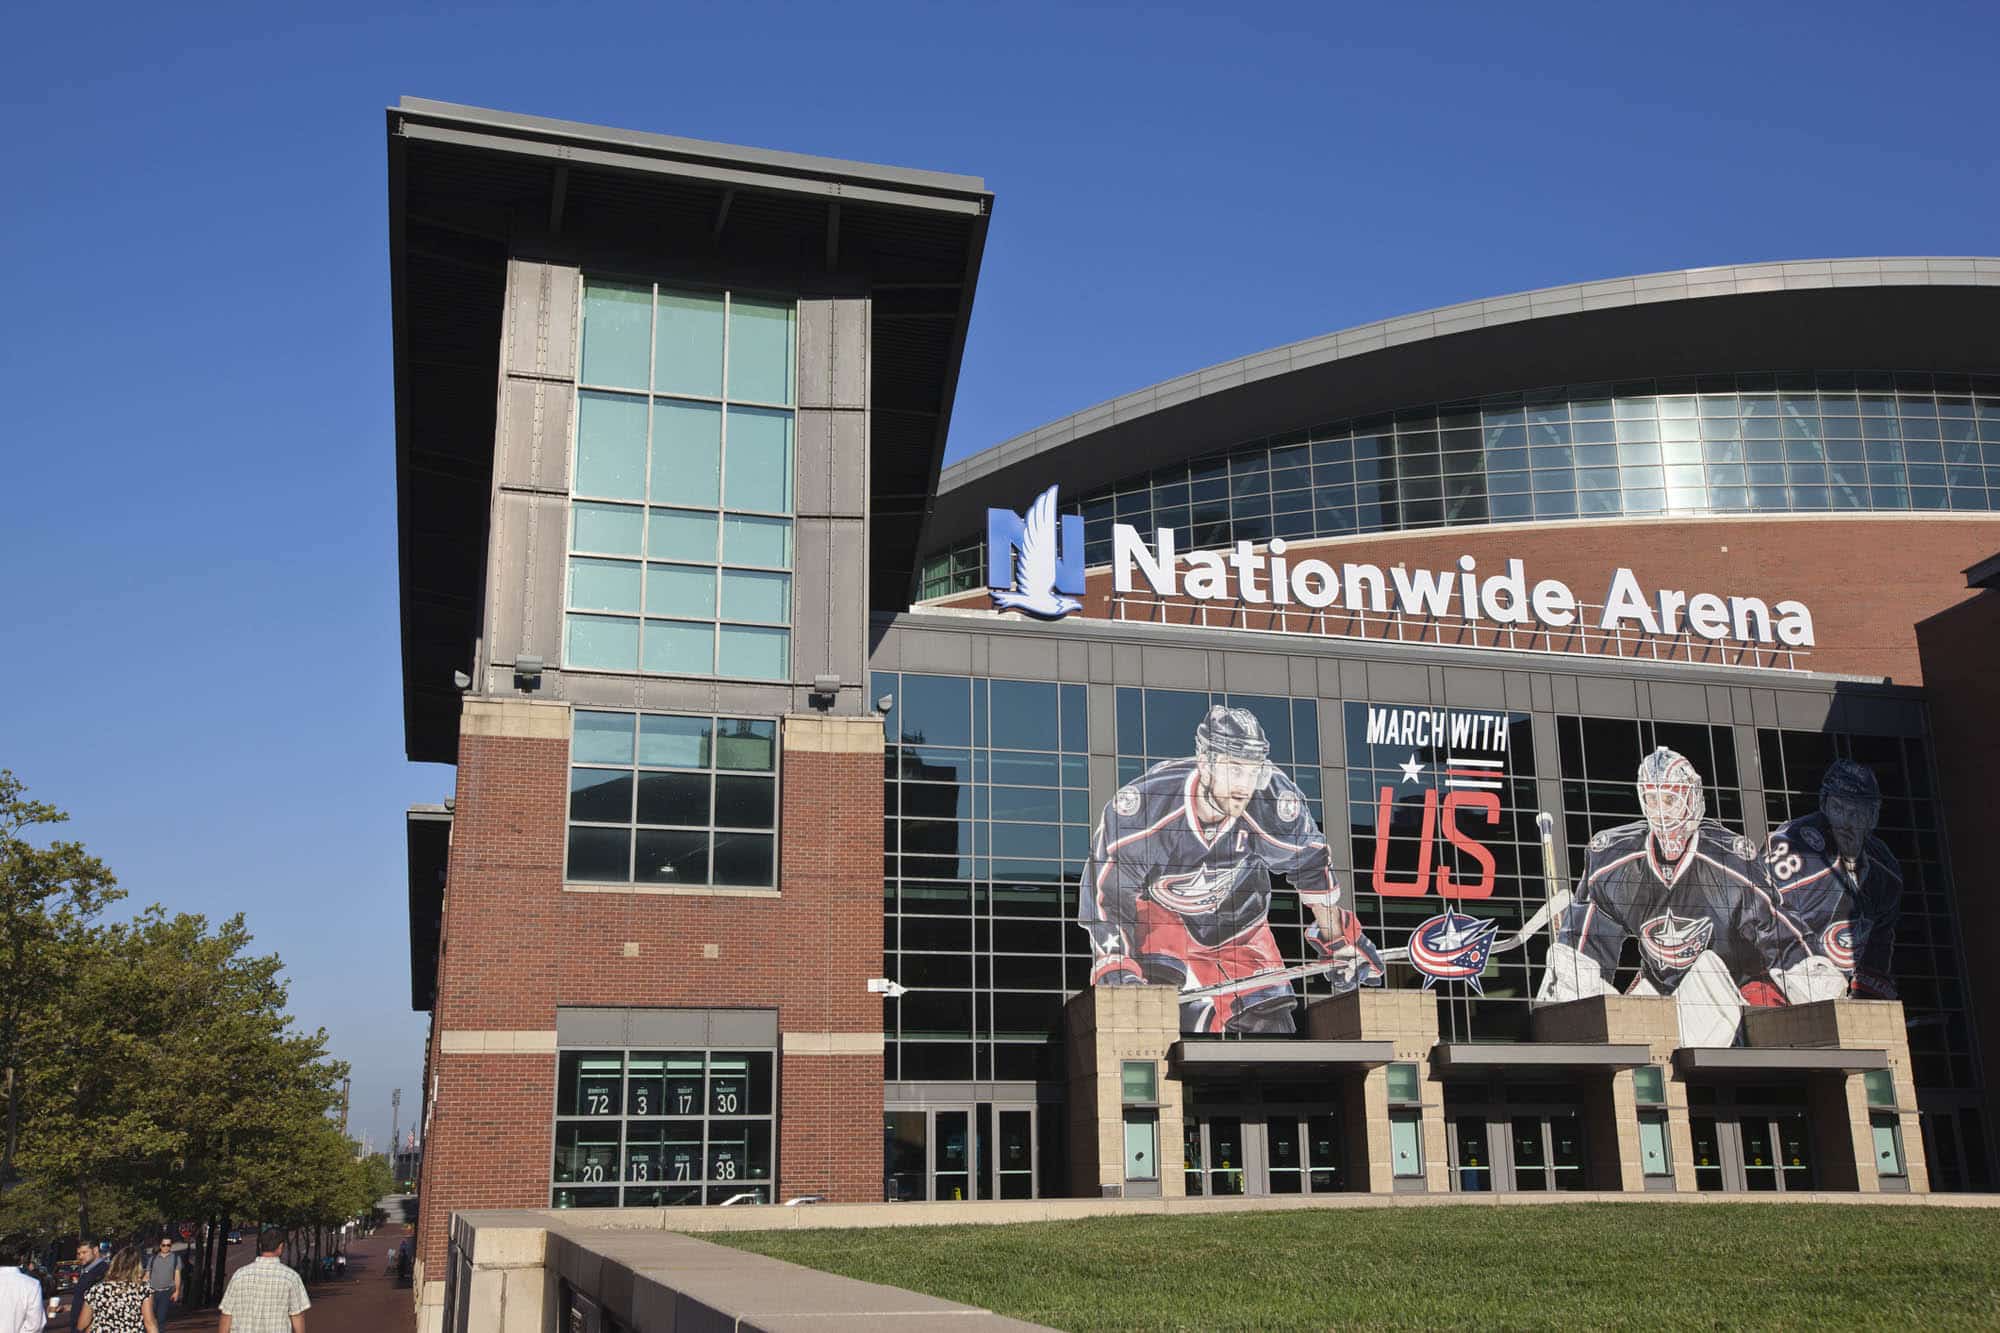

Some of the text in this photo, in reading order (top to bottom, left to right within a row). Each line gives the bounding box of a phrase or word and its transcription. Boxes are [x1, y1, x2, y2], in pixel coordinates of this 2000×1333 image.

[1112, 523, 1815, 647] Nationwide Arena
[1366, 707, 1510, 752] MARCH WITH
[1372, 786, 1501, 900] US
[587, 1095, 609, 1114] 72
[637, 1096, 648, 1115] 3
[679, 1095, 692, 1114] 17
[717, 1094, 737, 1113] 30
[583, 1165, 604, 1183] 20
[631, 1162, 648, 1182] 13
[674, 1162, 690, 1183] 71
[716, 1160, 736, 1180] 38
